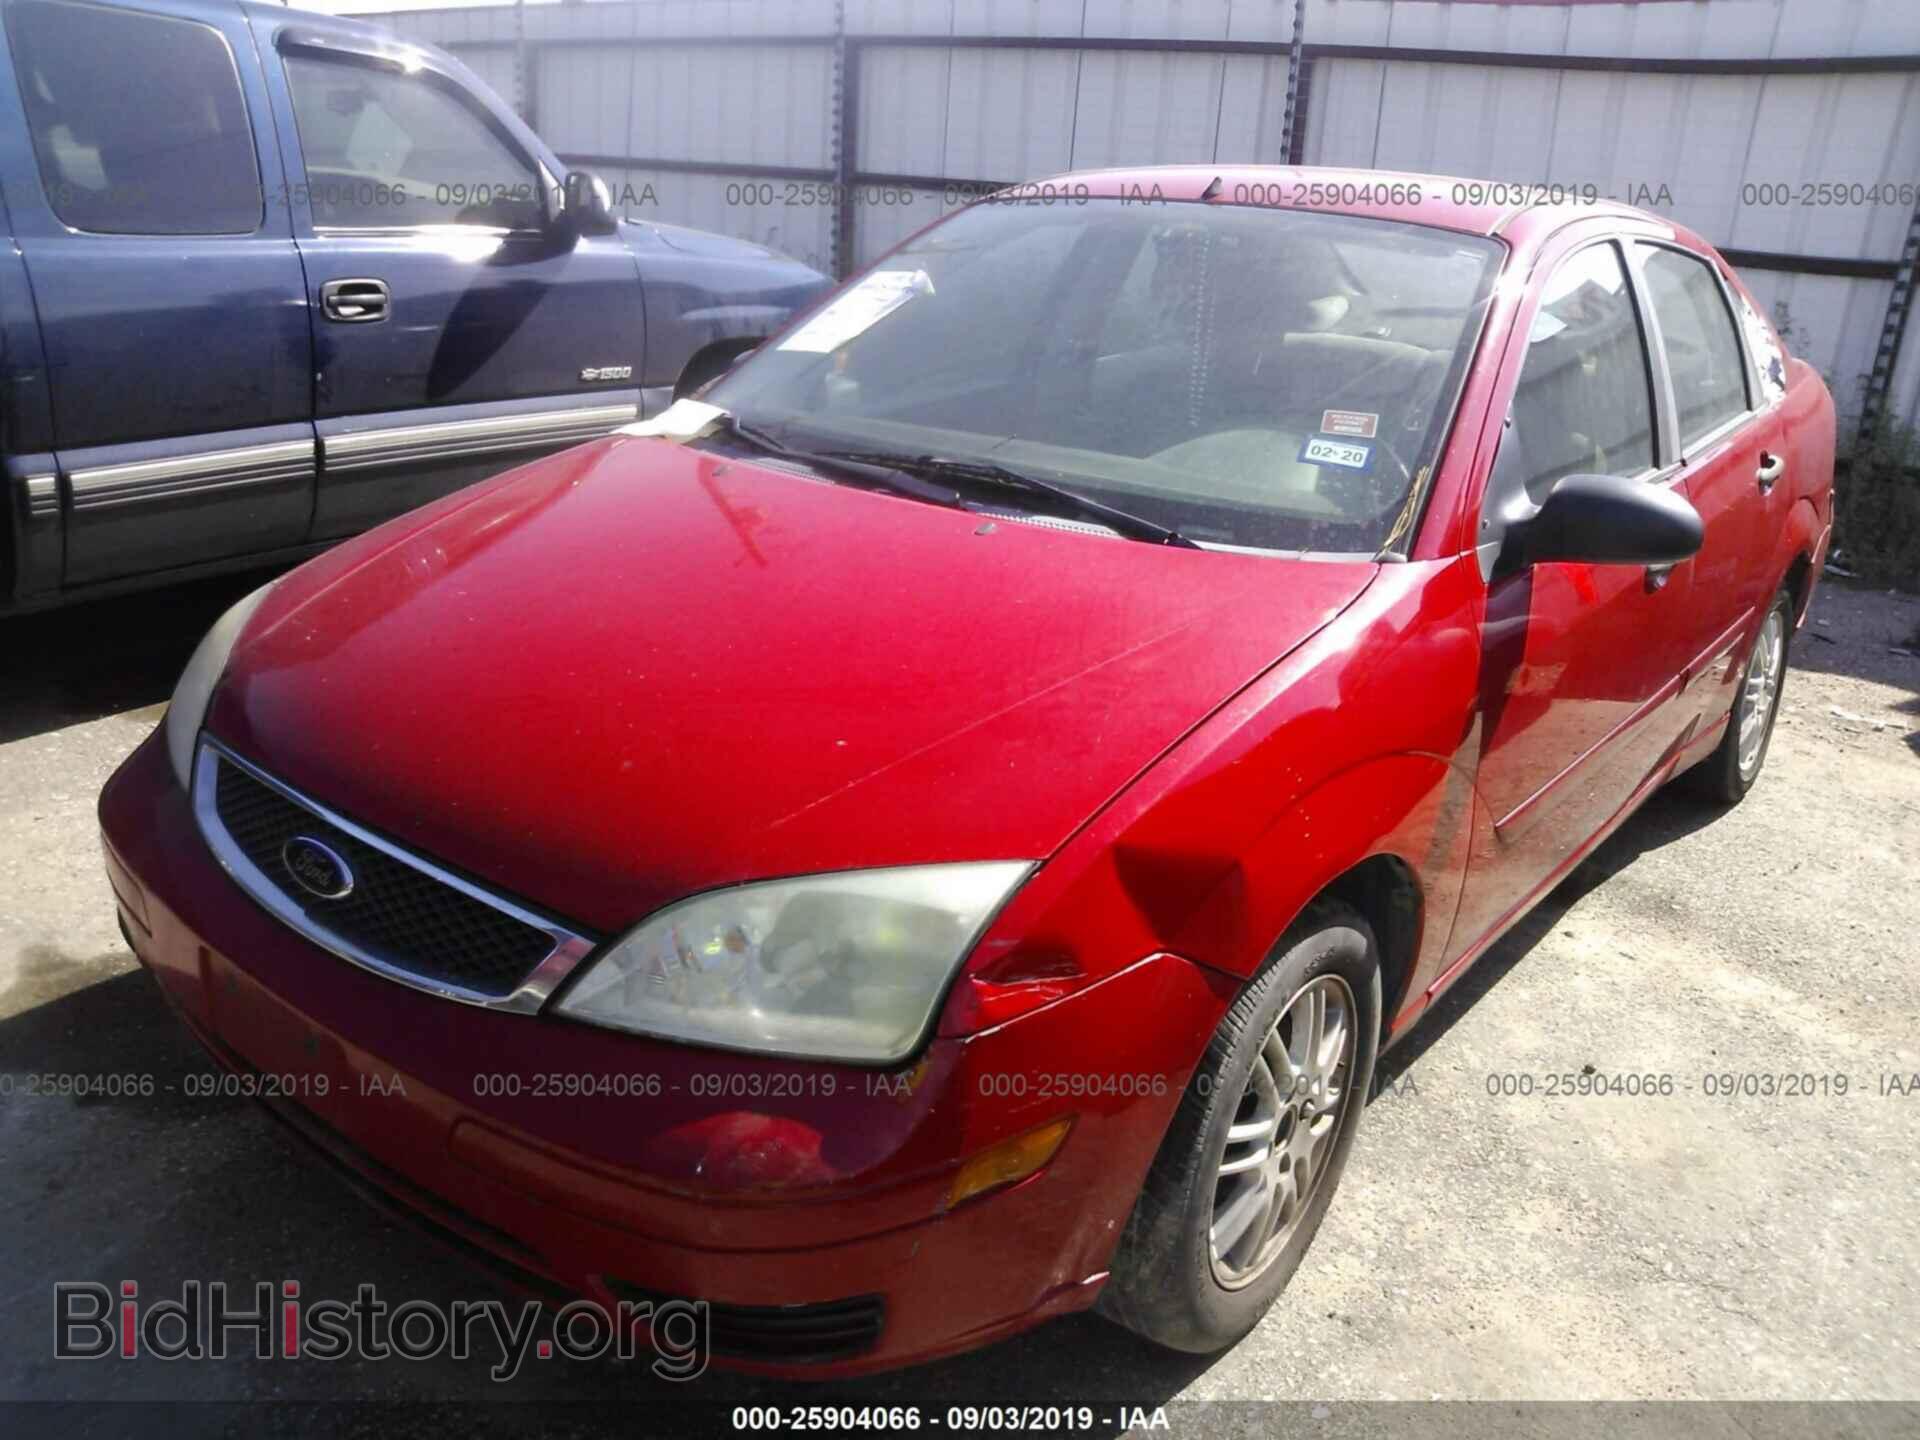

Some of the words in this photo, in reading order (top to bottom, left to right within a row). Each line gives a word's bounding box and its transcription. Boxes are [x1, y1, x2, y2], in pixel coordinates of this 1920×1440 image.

[600, 366, 632, 379] 1500
[1311, 445, 1334, 457] 02
[1341, 450, 1363, 463] 20
[295, 847, 333, 887] Ford
